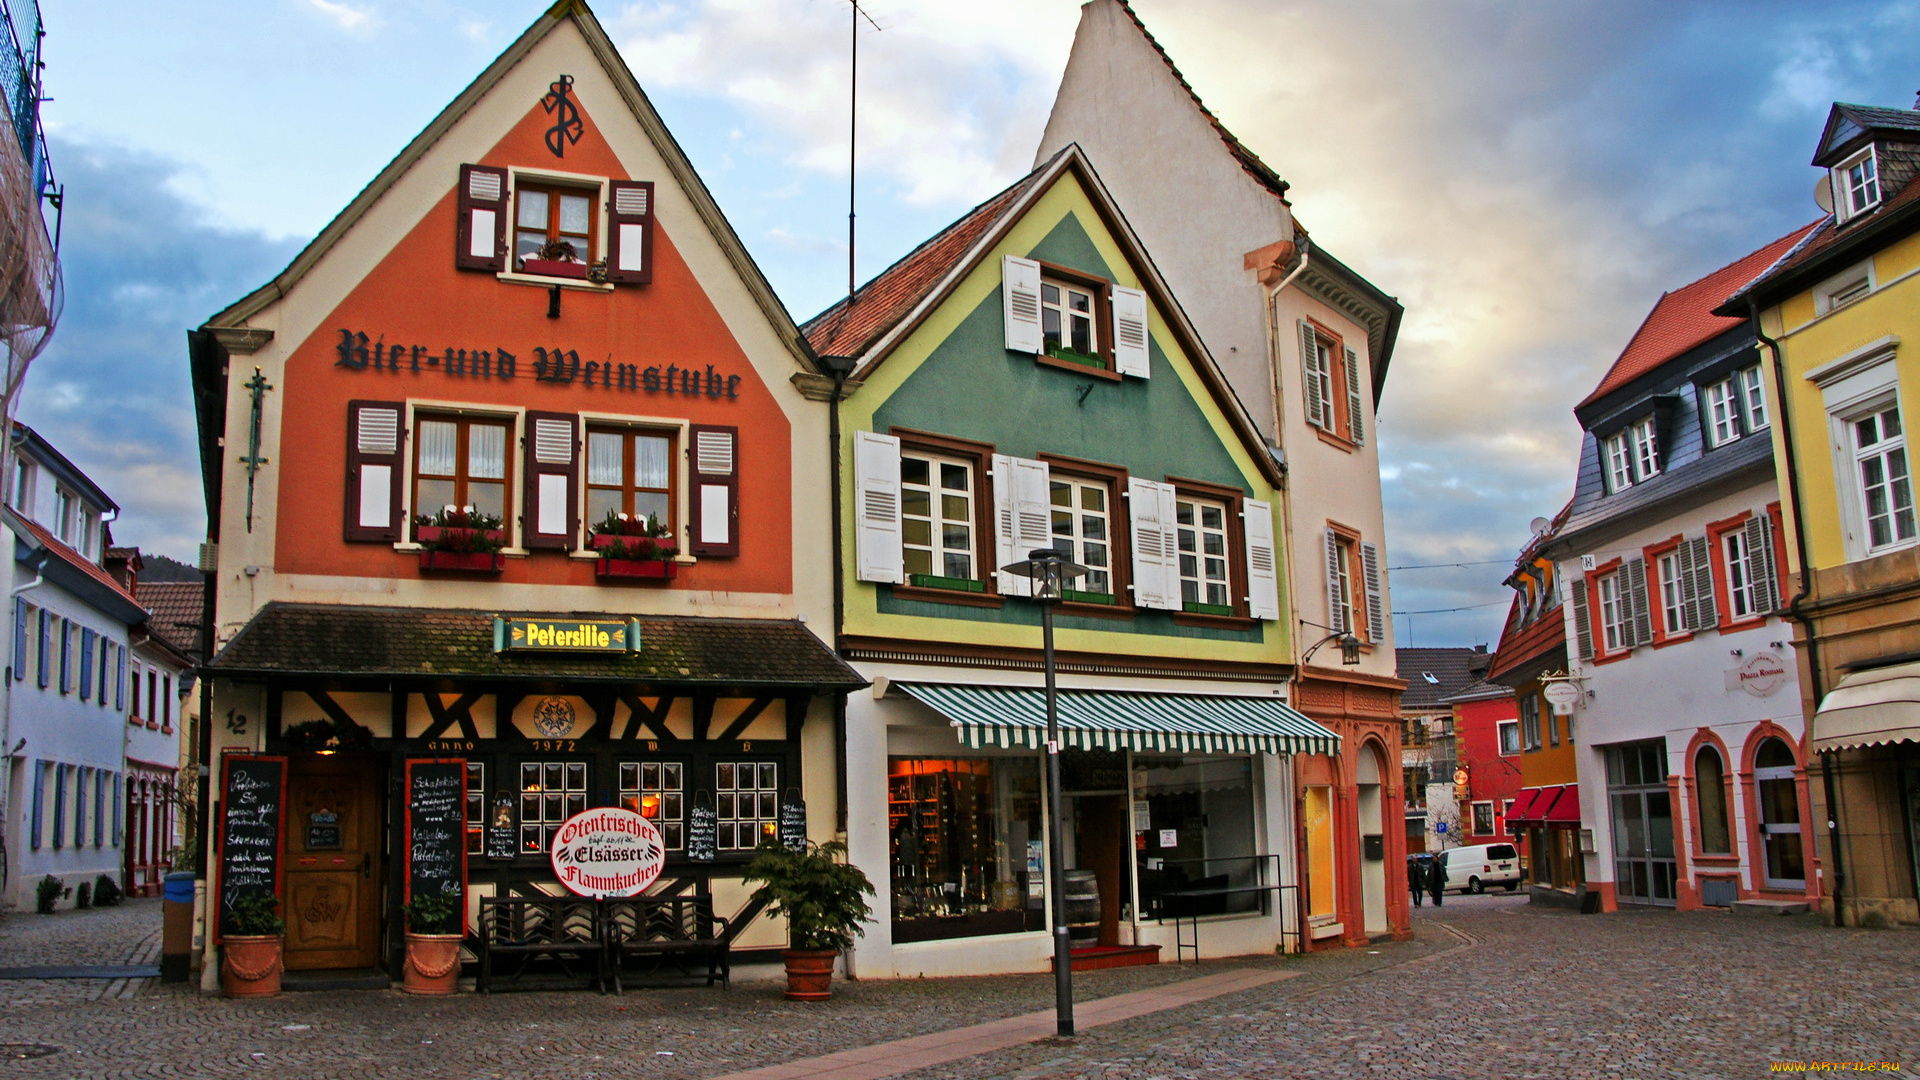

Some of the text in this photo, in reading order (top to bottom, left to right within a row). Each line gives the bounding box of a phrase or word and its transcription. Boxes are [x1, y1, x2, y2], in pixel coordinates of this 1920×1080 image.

[532, 347, 742, 399] Weinstube
[527, 623, 610, 648] Petersilie
[226, 708, 247, 735] 12
[532, 740, 576, 752] 1972
[562, 813, 655, 844] Ofenfrischer
[1438, 823, 1445, 832] P
[574, 845, 643, 863] Elsässer
[562, 863, 659, 891] Flammkuchen
